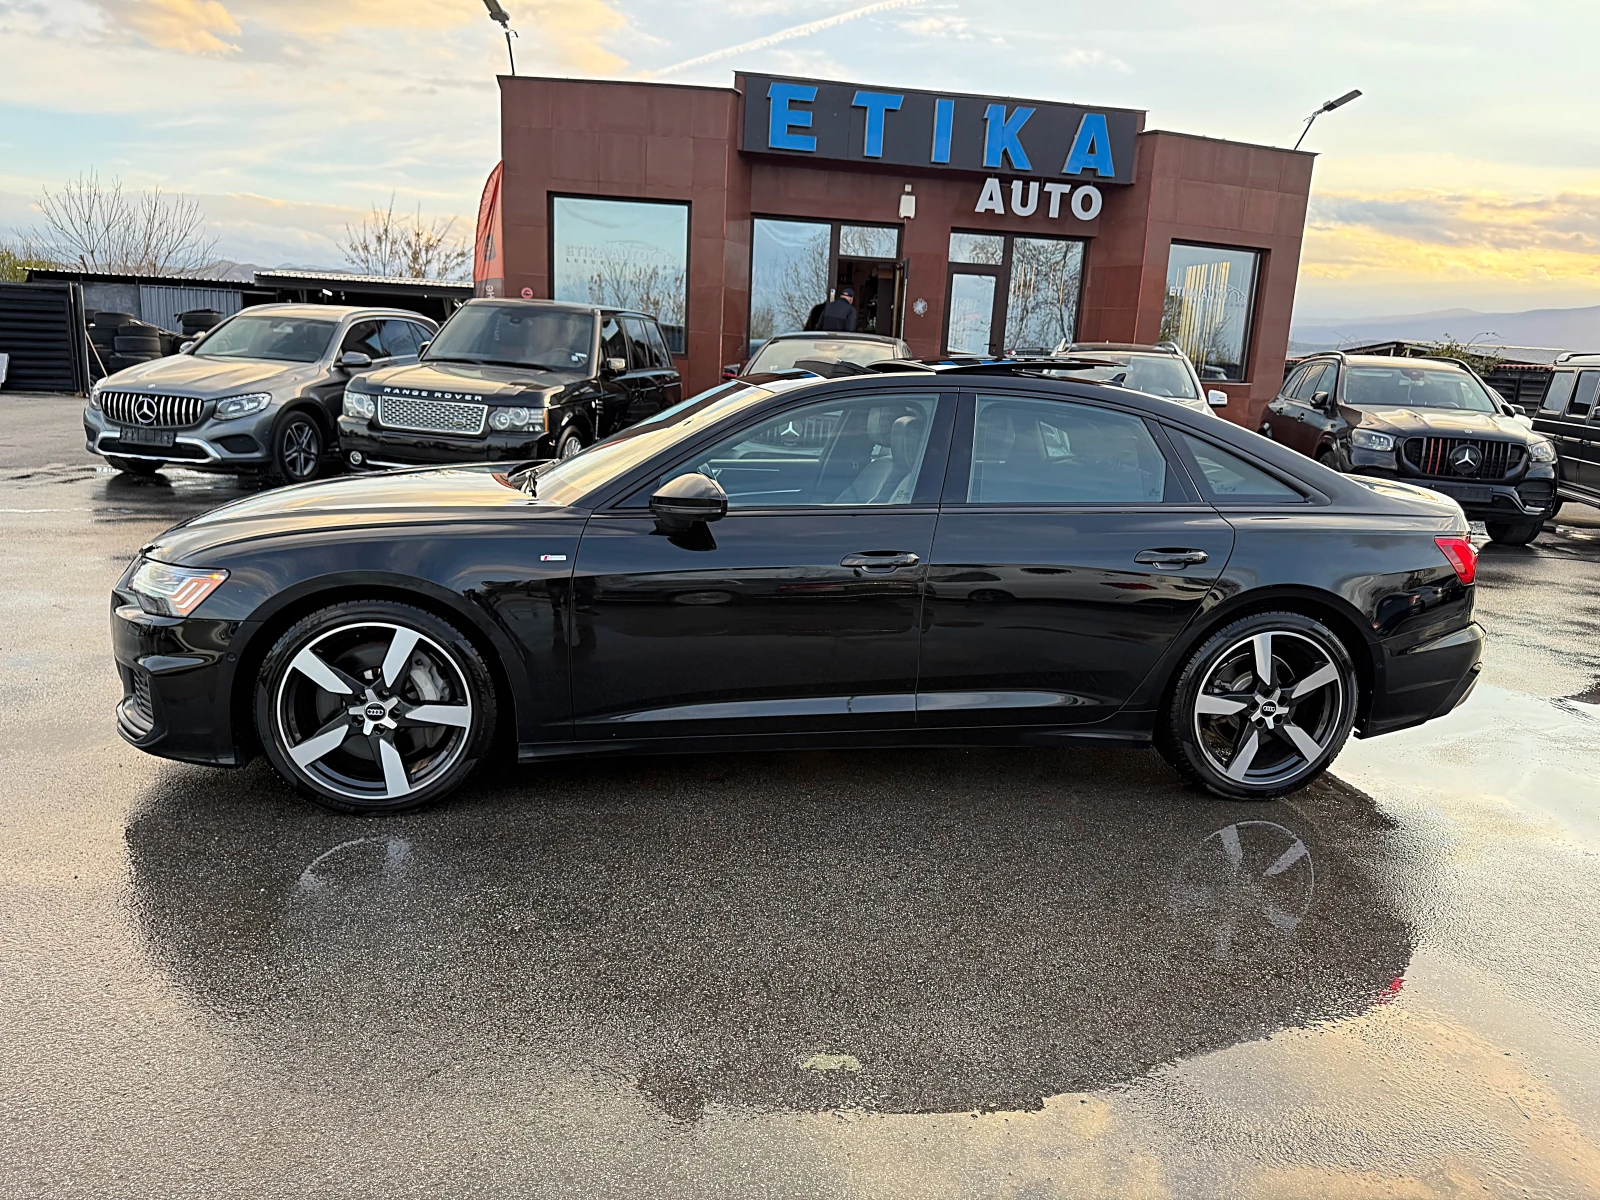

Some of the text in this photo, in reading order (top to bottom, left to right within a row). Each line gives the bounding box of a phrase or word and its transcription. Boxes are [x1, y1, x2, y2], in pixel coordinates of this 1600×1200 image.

[766, 82, 1115, 178] ETIKA
[974, 177, 1103, 221] AUTO
[565, 245, 649, 262] ETIKA AUTO
[383, 387, 482, 401] RANGE ROVER
